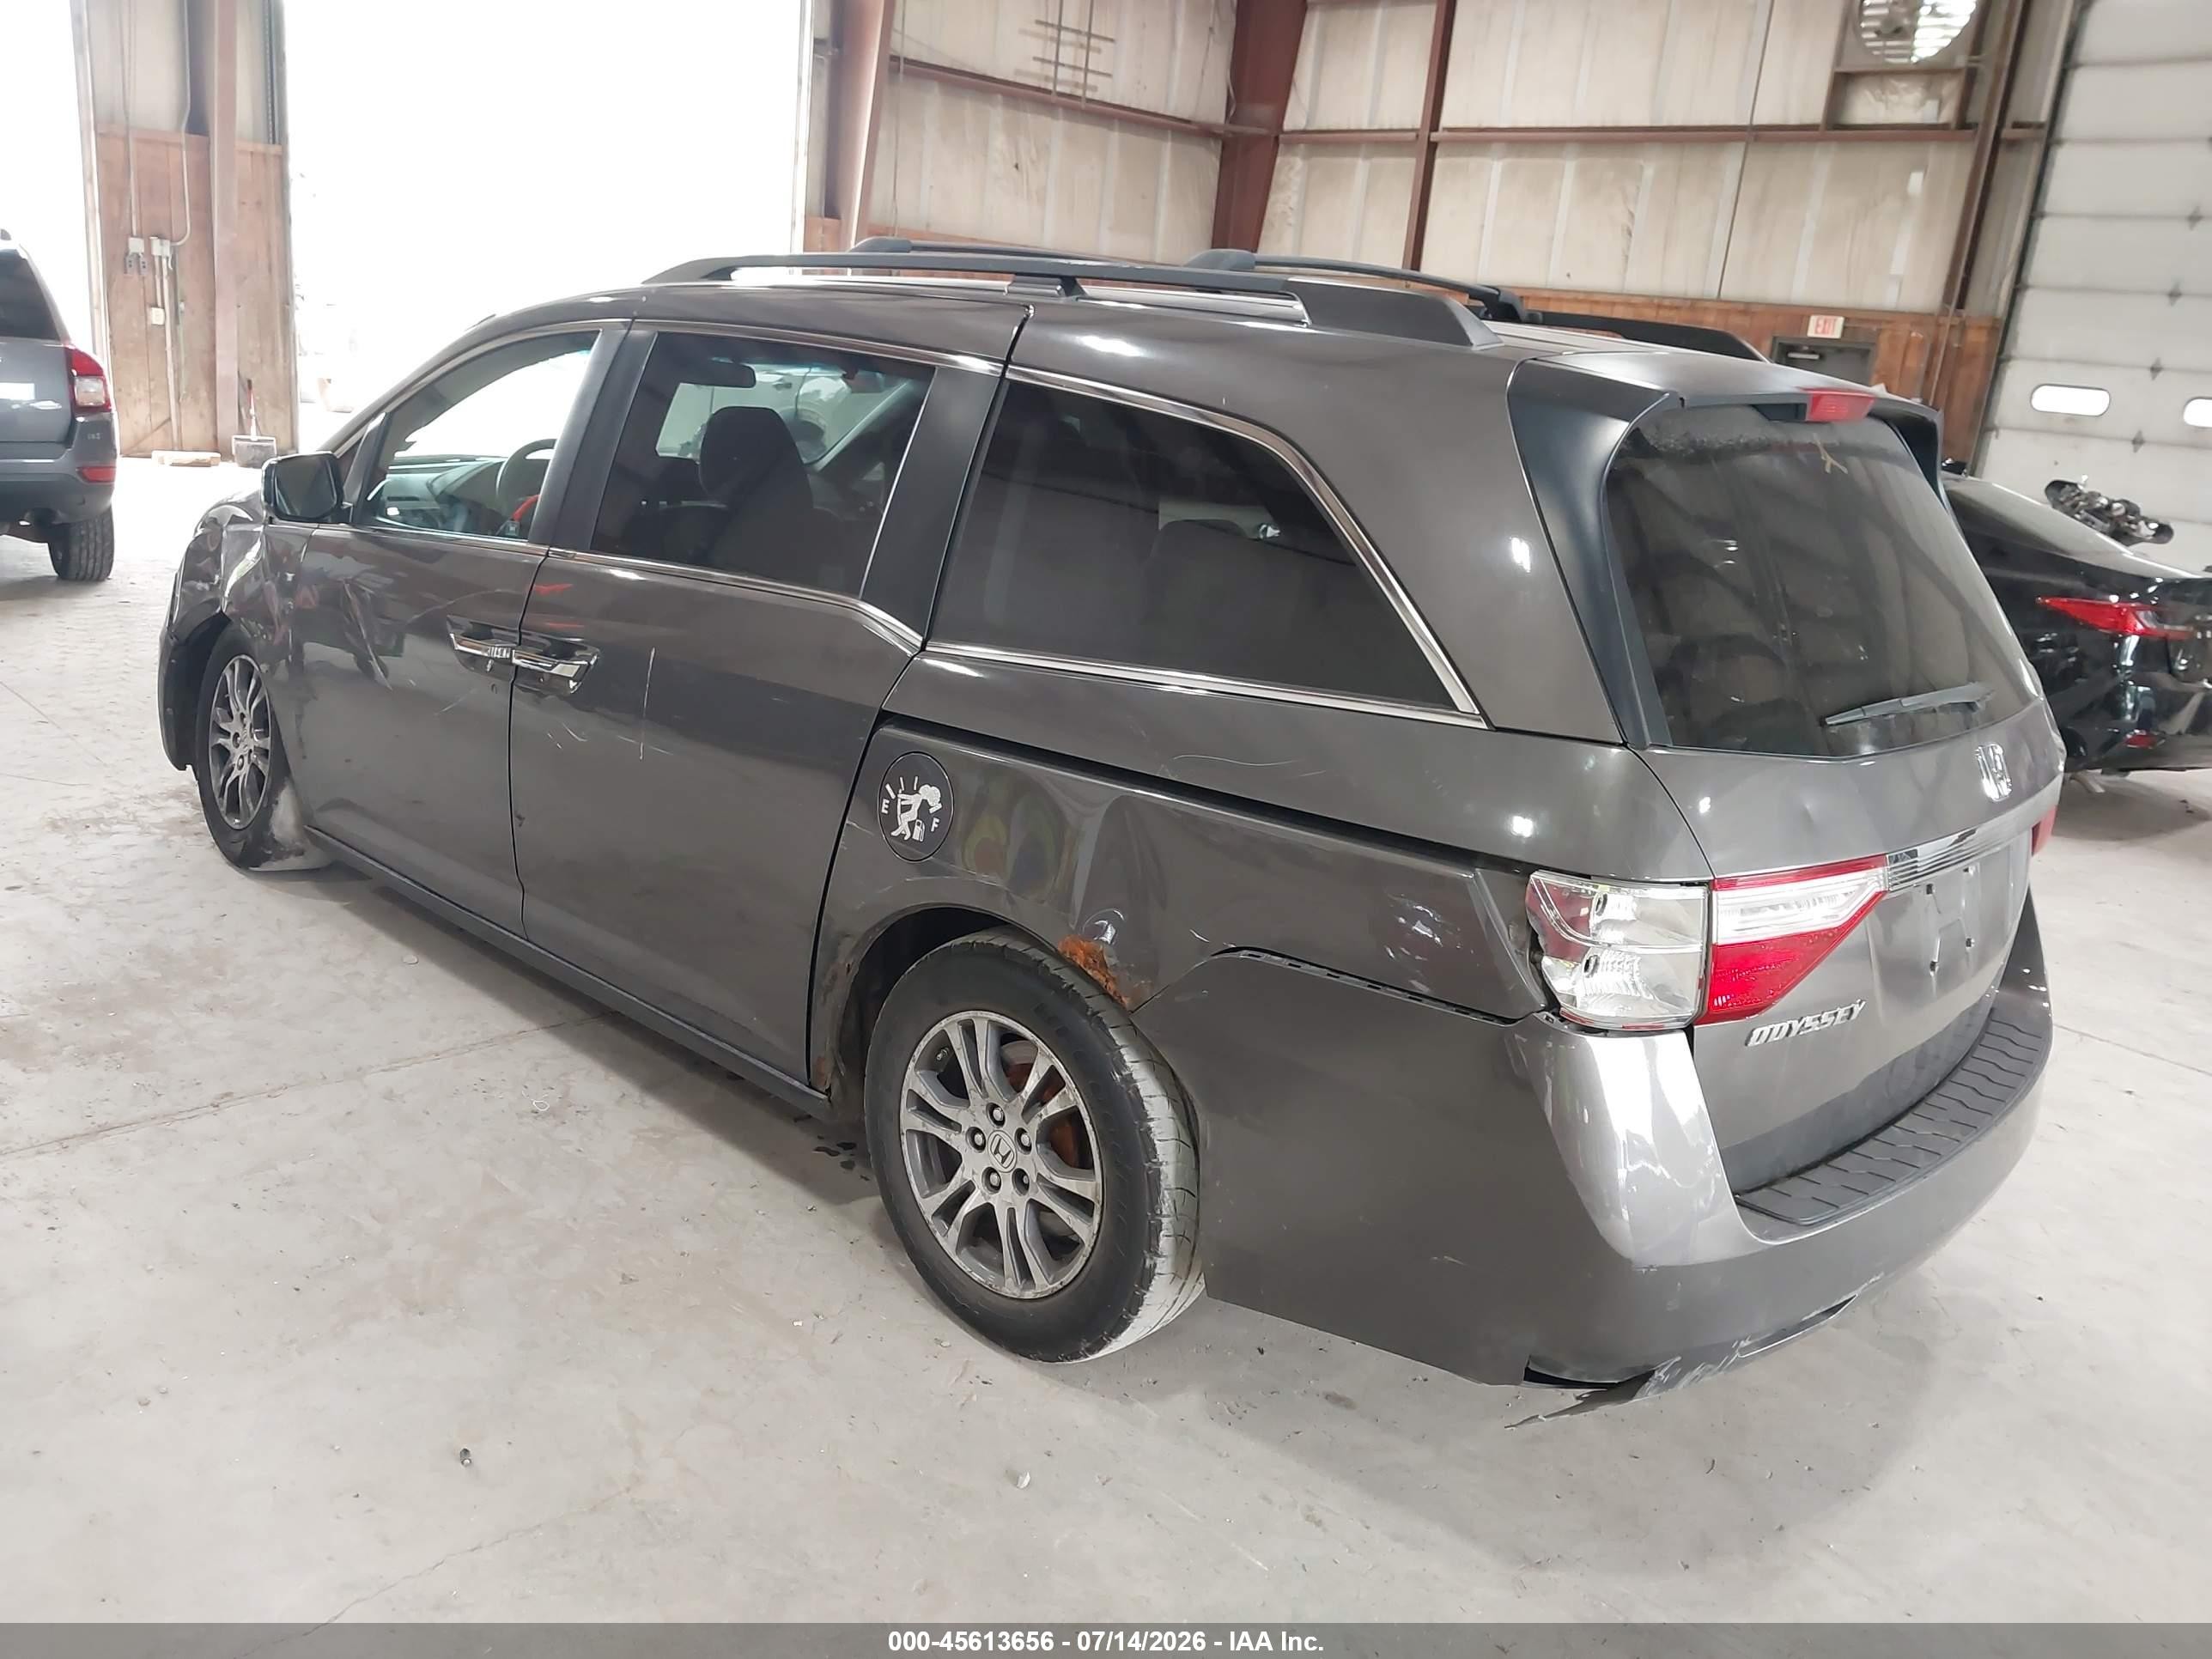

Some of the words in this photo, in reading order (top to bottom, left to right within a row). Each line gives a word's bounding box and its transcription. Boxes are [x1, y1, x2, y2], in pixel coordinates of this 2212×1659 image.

[1814, 316, 1837, 336] EXIT
[881, 799, 890, 814] E
[931, 817, 940, 832] F
[1745, 999, 1867, 1047] ODYSSEY
